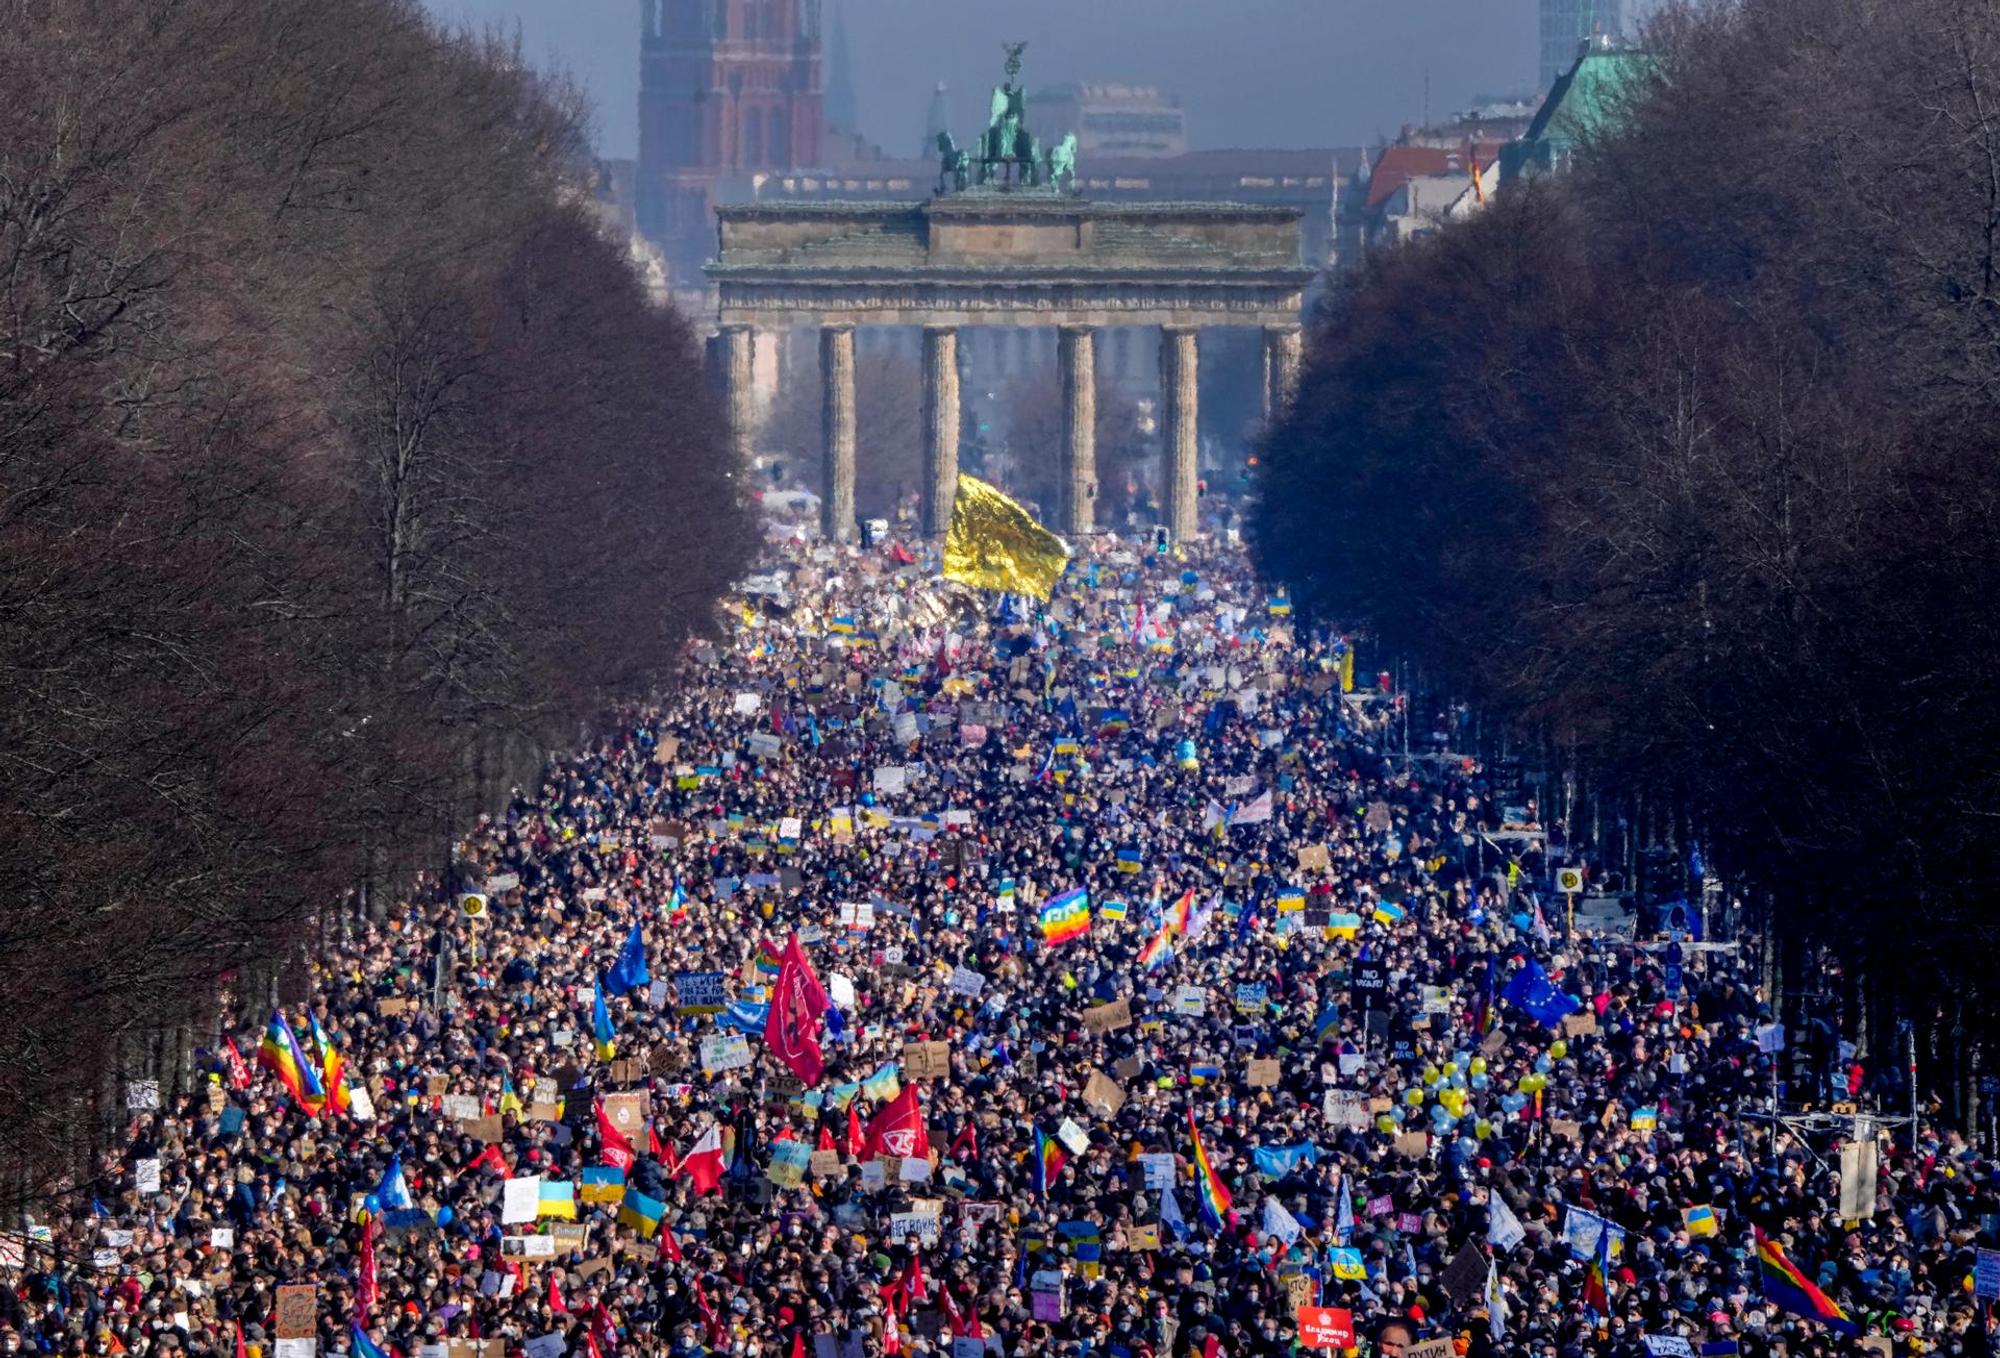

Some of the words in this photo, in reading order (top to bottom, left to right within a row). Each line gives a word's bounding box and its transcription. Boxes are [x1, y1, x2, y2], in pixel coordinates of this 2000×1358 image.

[1362, 969, 1379, 979] NO
[1394, 1040, 1410, 1050] NO
[767, 1077, 801, 1090] STOP
